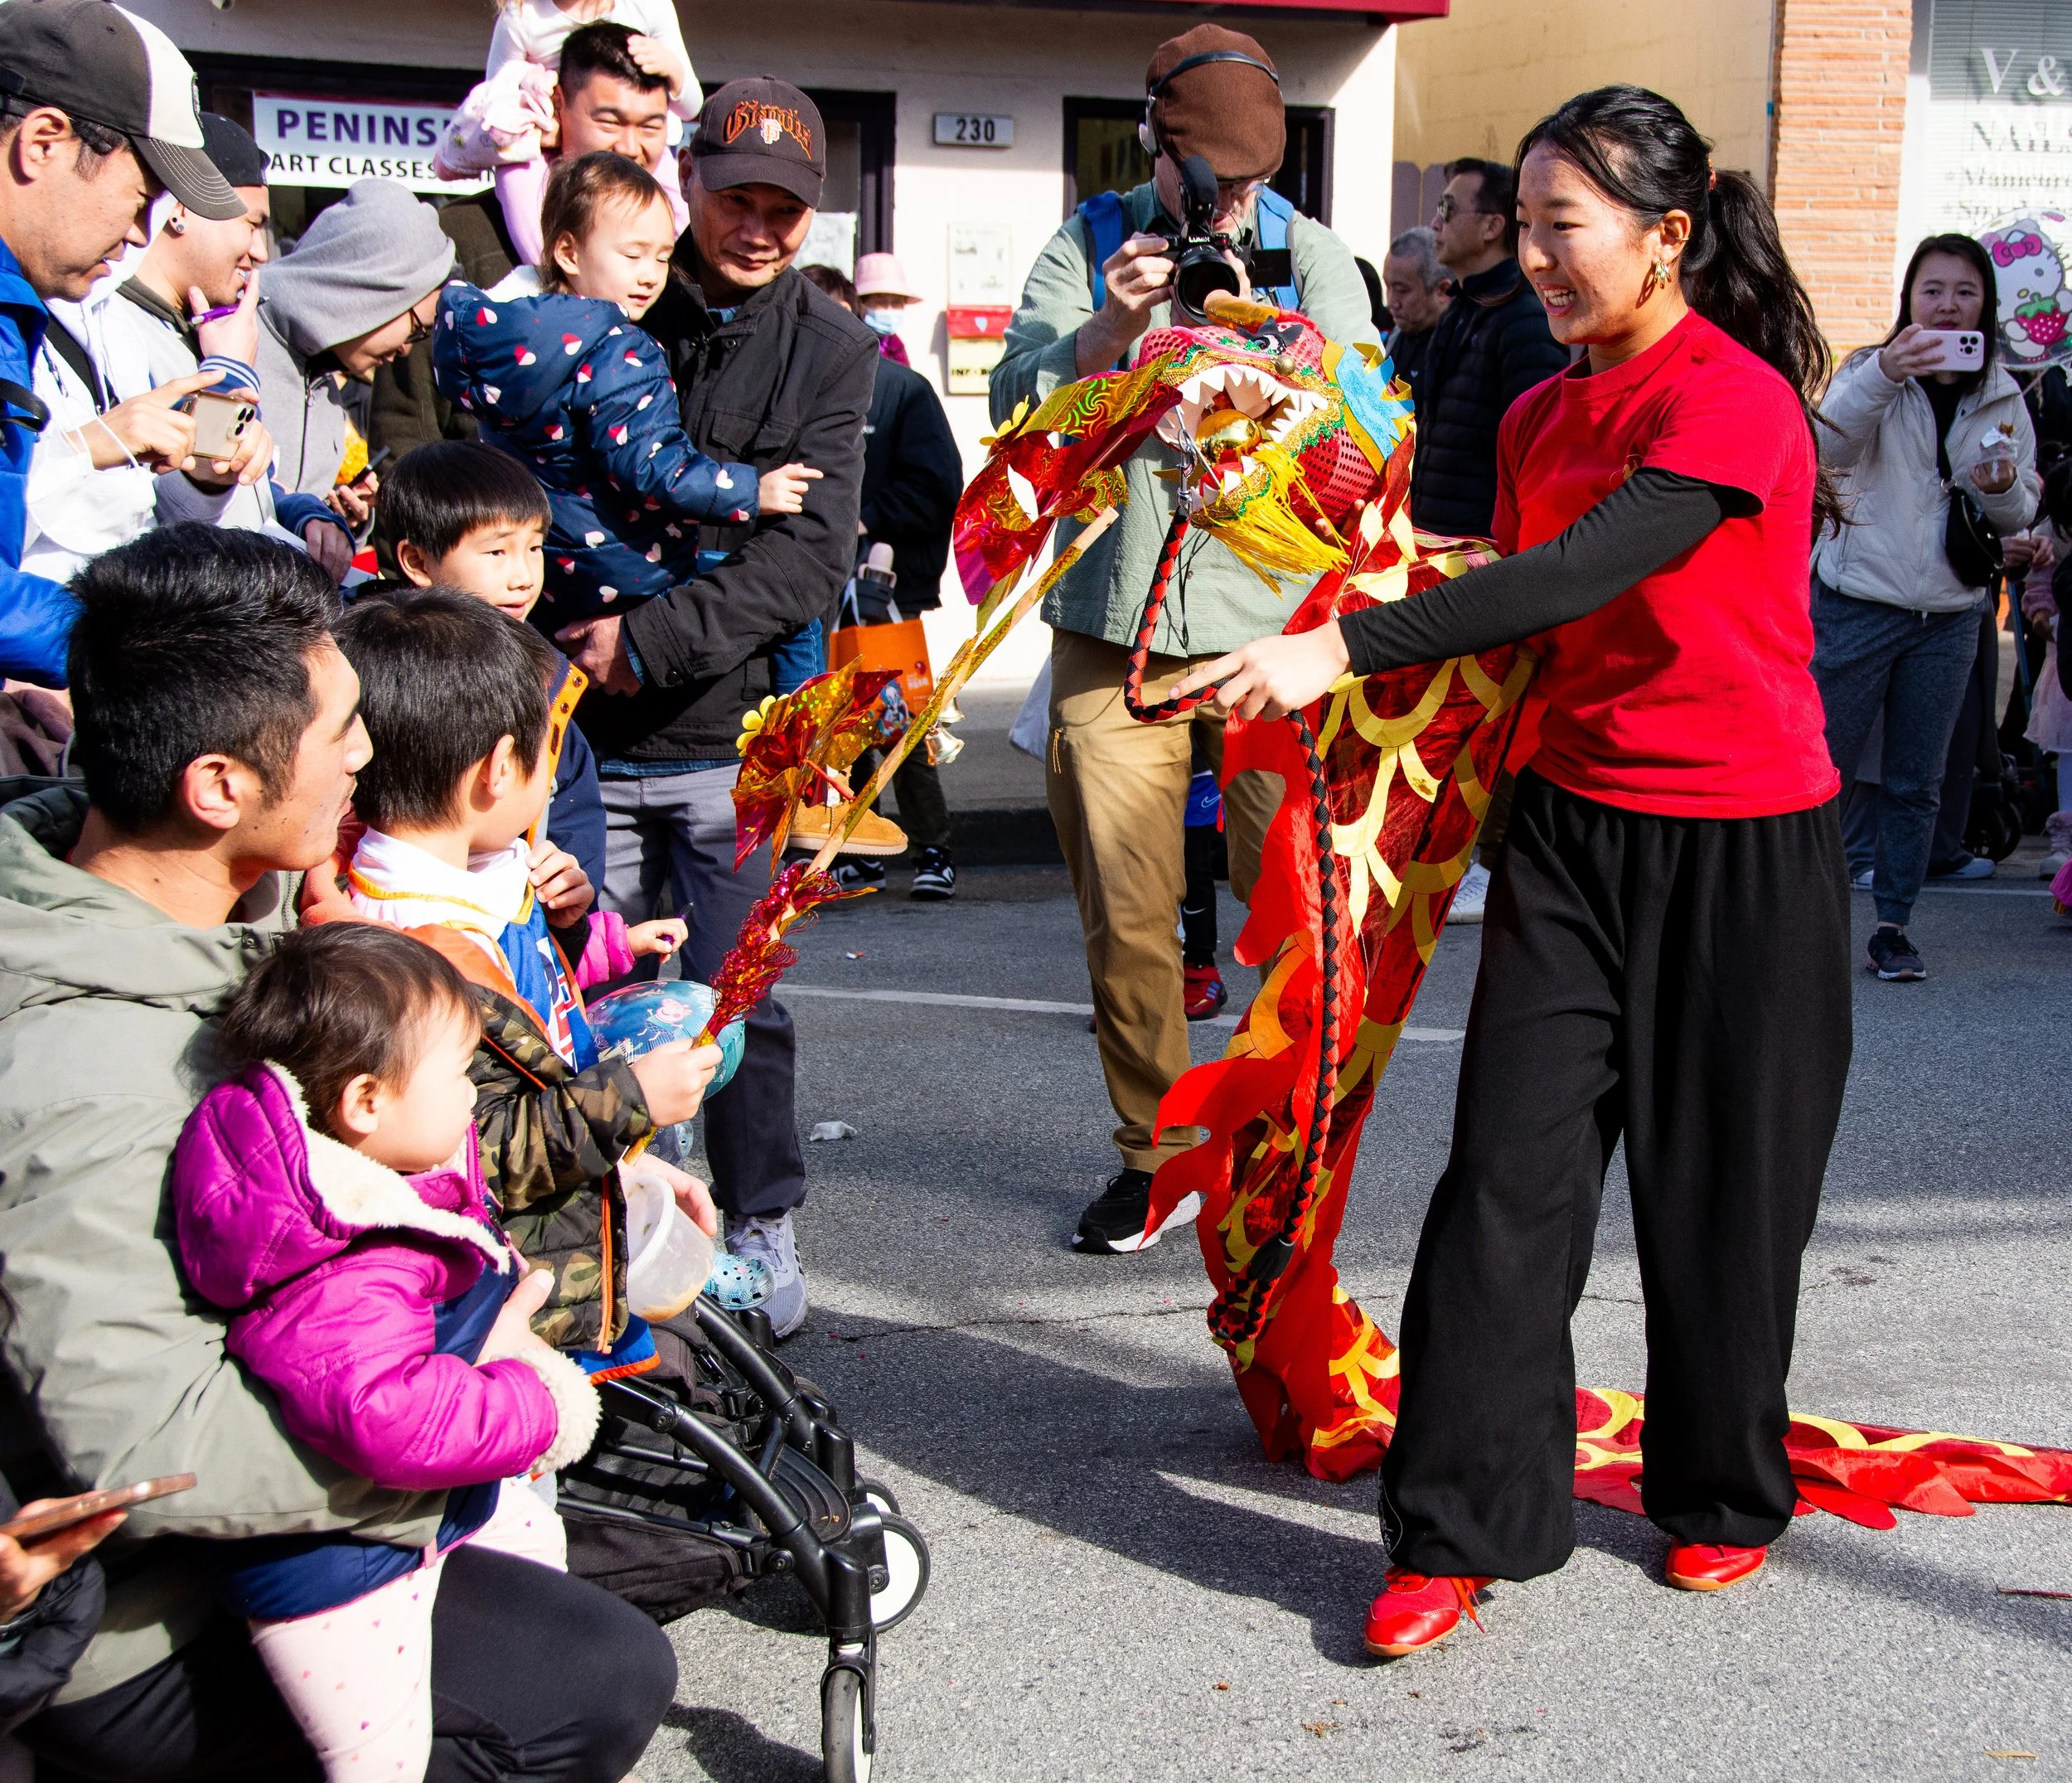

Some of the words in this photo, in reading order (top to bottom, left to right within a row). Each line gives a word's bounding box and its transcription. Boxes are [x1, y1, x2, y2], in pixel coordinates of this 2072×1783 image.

[1980, 47, 2021, 94] V
[2026, 55, 2065, 96] &
[276, 109, 452, 147] PENINS
[722, 99, 812, 160] Giants
[956, 118, 995, 143] 230
[270, 153, 320, 173] ART
